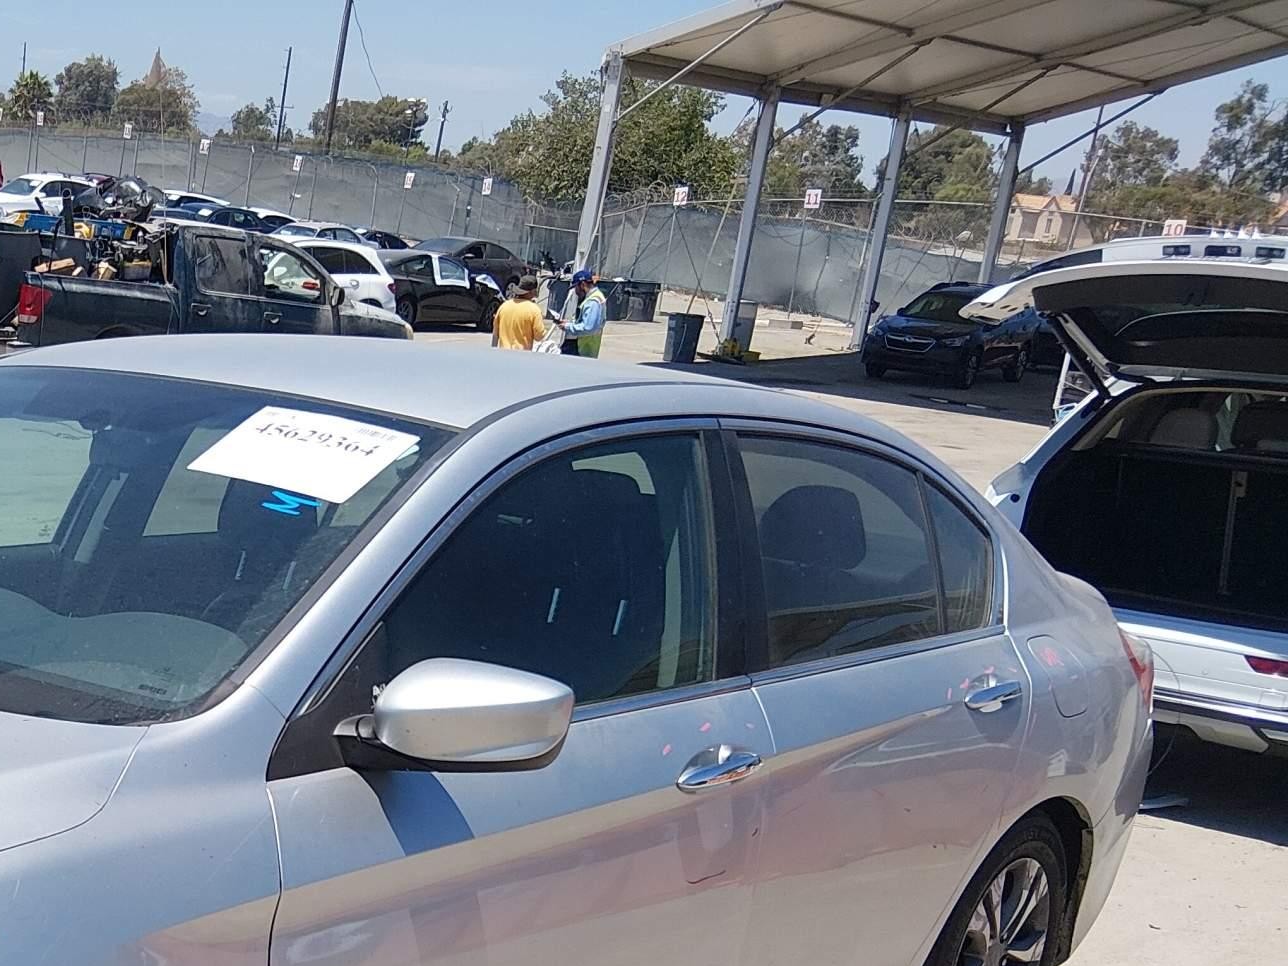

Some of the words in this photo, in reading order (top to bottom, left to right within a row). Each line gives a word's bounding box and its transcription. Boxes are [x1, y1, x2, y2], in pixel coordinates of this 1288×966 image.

[675, 191, 687, 203] 12
[806, 193, 819, 205] 11
[1164, 223, 1184, 237] 10
[255, 422, 382, 457] 45629364
